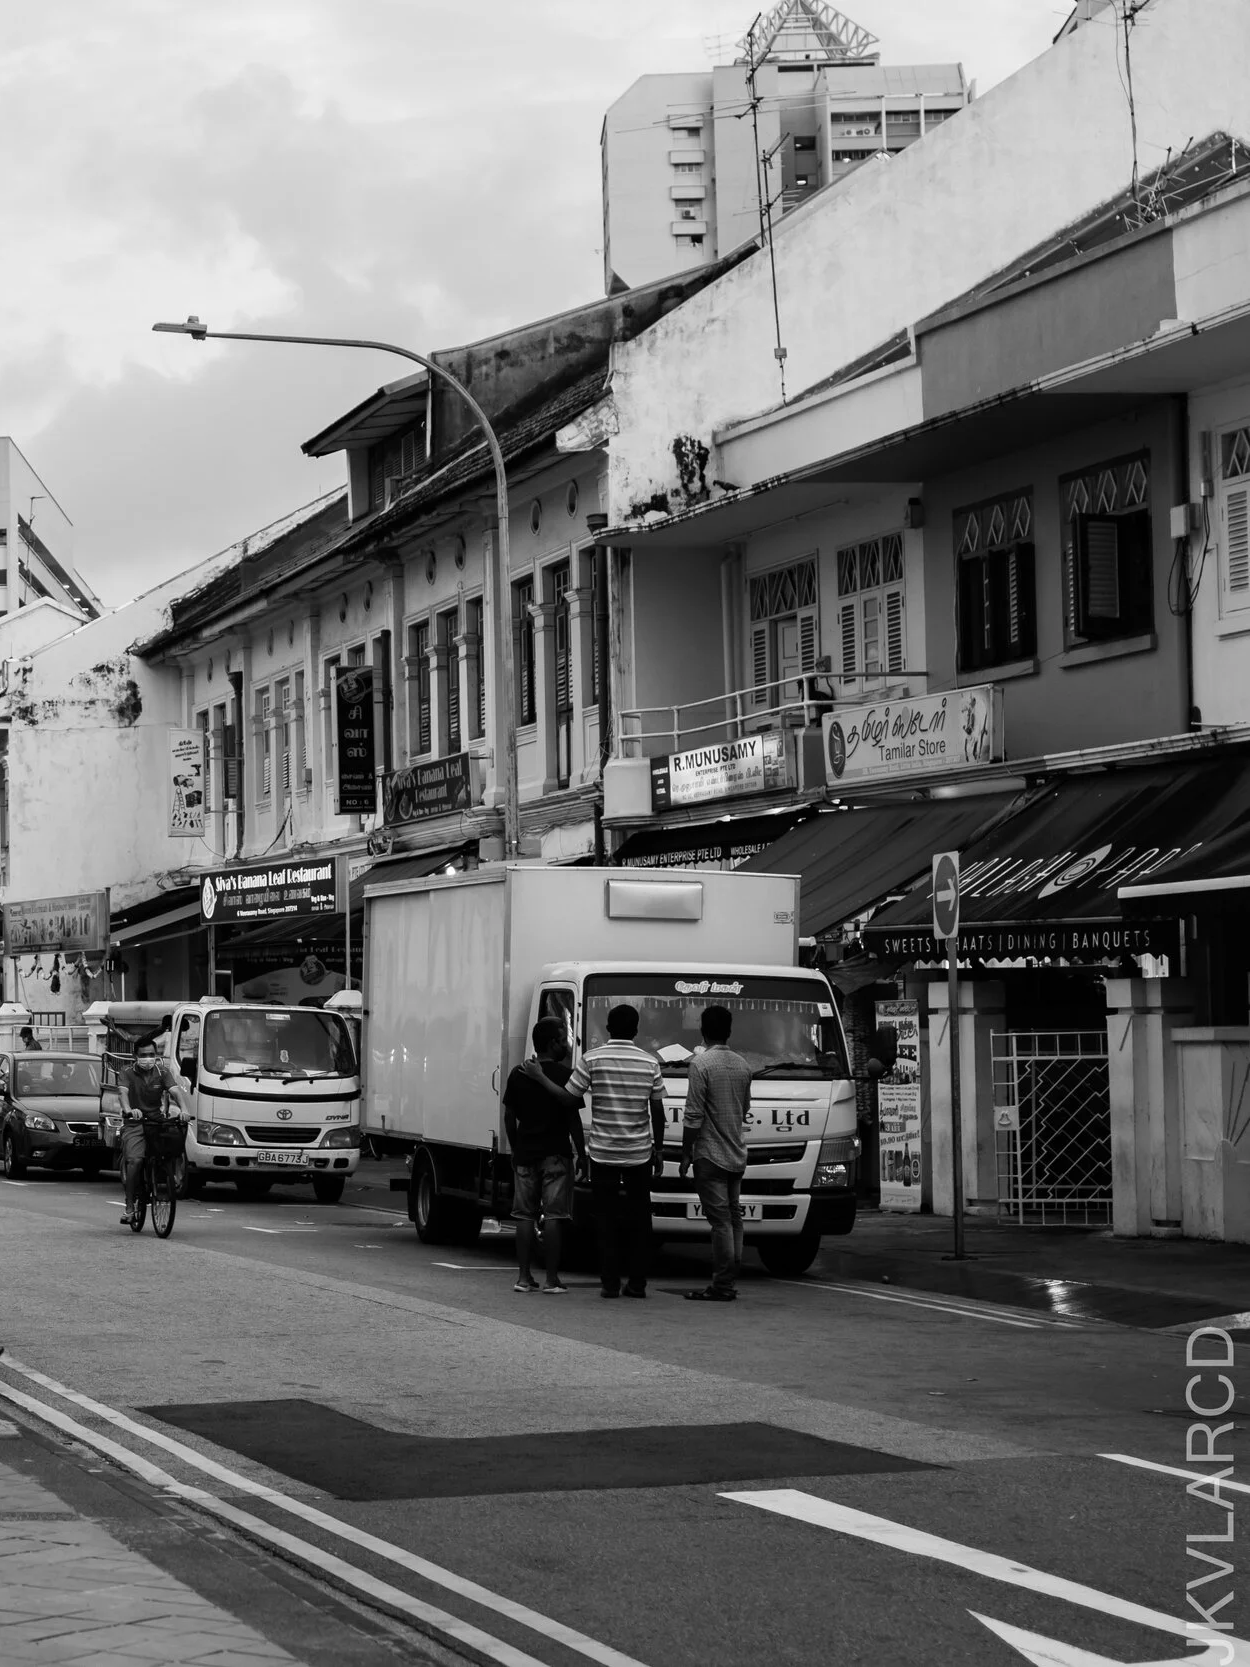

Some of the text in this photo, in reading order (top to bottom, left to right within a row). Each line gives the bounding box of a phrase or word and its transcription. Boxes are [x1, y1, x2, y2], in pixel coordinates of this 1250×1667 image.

[673, 740, 757, 773] R.MUNUSAMY
[878, 738, 946, 762] Tamilar Store
[626, 855, 659, 868] MUNUSAMY
[659, 850, 696, 865] ENTERPRISE
[696, 849, 709, 861] PTE
[709, 847, 722, 859] LTD
[731, 843, 762, 857] WHOLESALE
[215, 875, 237, 892] Siva's
[237, 873, 268, 890] Banana
[268, 868, 286, 886] Leaf
[286, 863, 332, 884] Restaurant
[884, 936, 931, 954] SWEETS
[1007, 932, 1057, 950] DINING
[1071, 929, 1151, 950] BANQUETS
[771, 1109, 810, 1126] Ltd
[258, 1152, 310, 1165] GBA6773J
